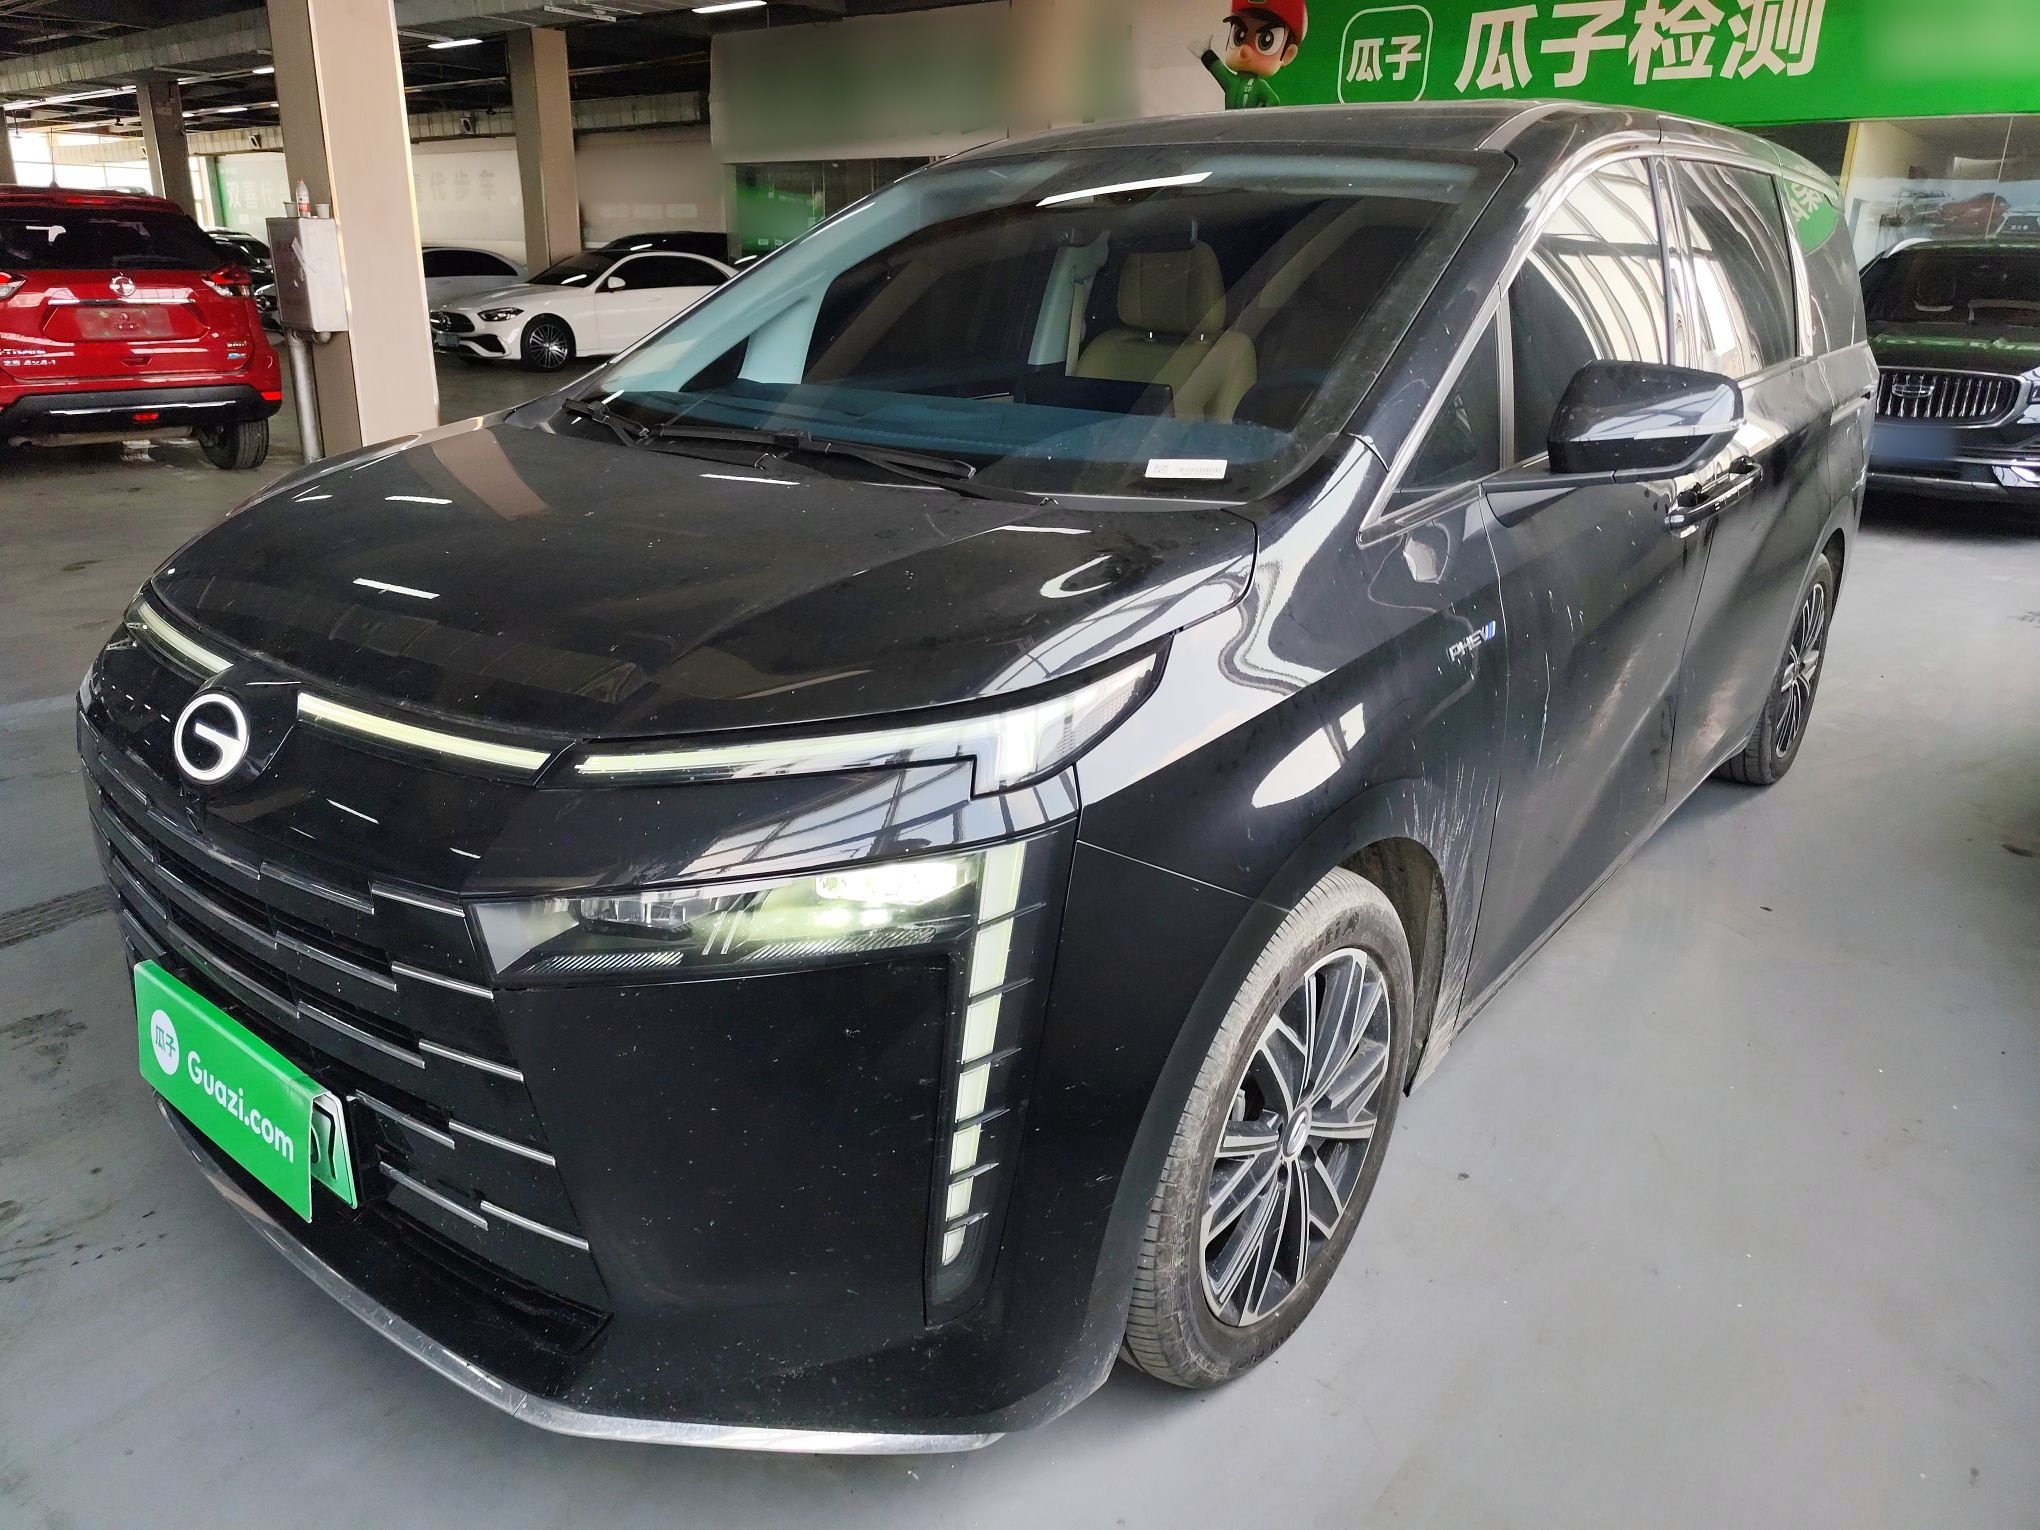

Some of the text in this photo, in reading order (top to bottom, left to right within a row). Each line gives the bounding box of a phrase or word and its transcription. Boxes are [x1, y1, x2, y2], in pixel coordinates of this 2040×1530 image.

[1346, 35, 1422, 83] 瓜子
[1453, 0, 1826, 93] 瓜子检测
[155, 1024, 176, 1058] 瓜子
[187, 1050, 294, 1164] Guazi.com
